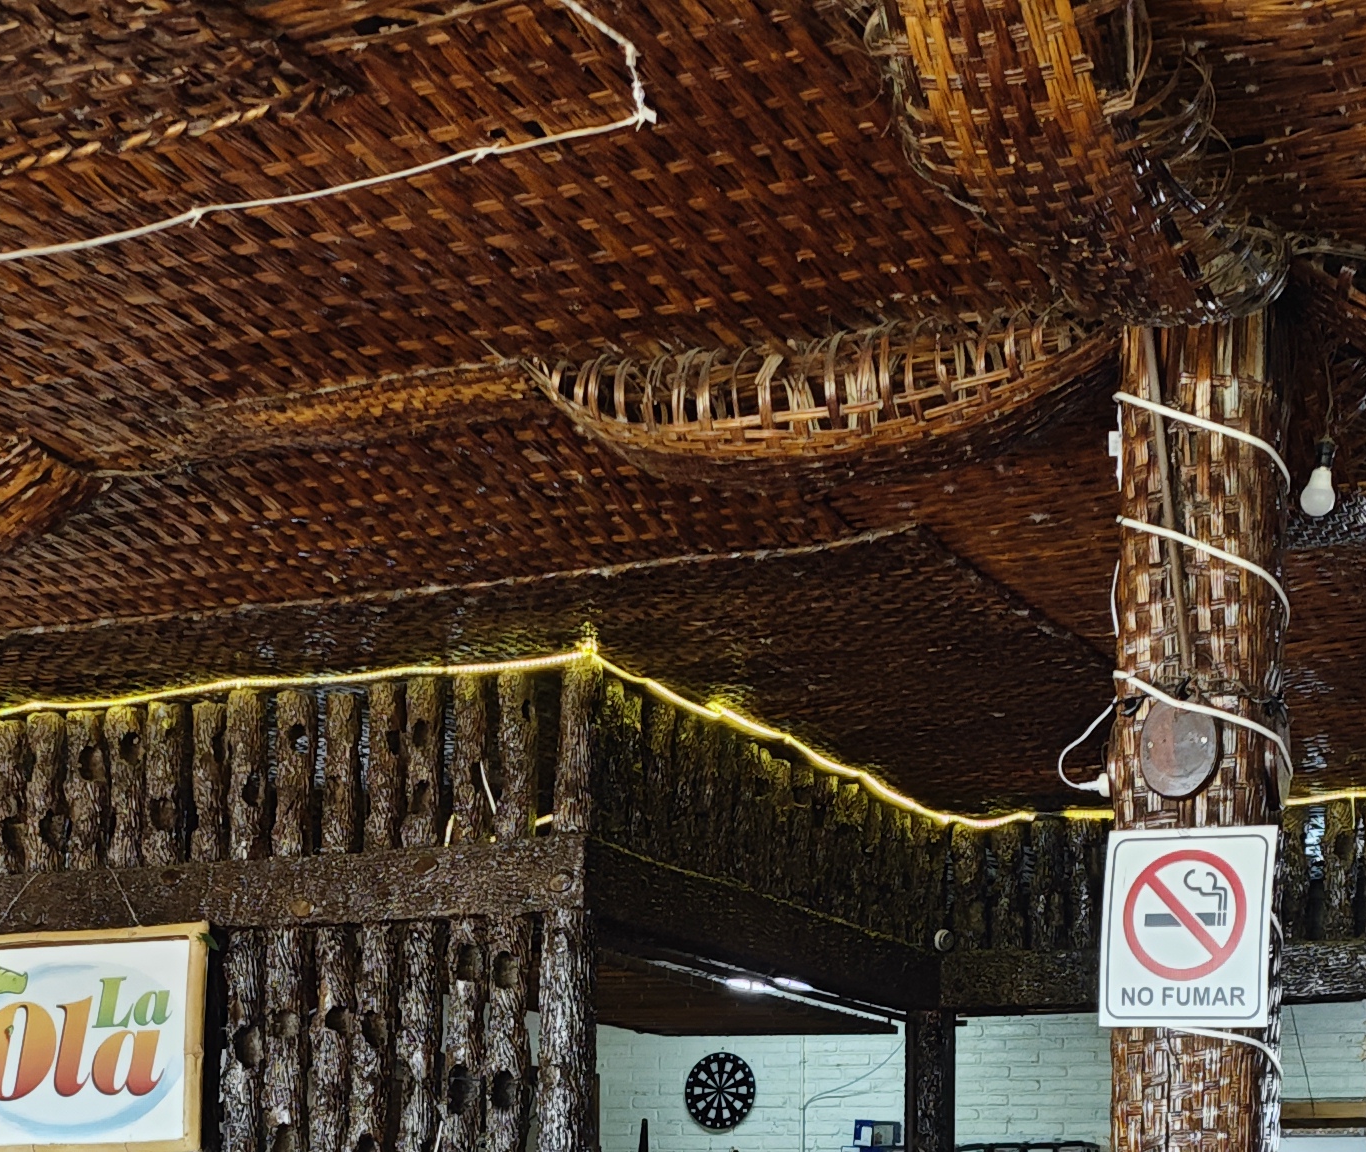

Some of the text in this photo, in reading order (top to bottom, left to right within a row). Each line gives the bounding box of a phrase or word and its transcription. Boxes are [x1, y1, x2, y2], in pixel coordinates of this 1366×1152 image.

[92, 976, 172, 1028] La
[1121, 986, 1246, 1006] NO FUMAR
